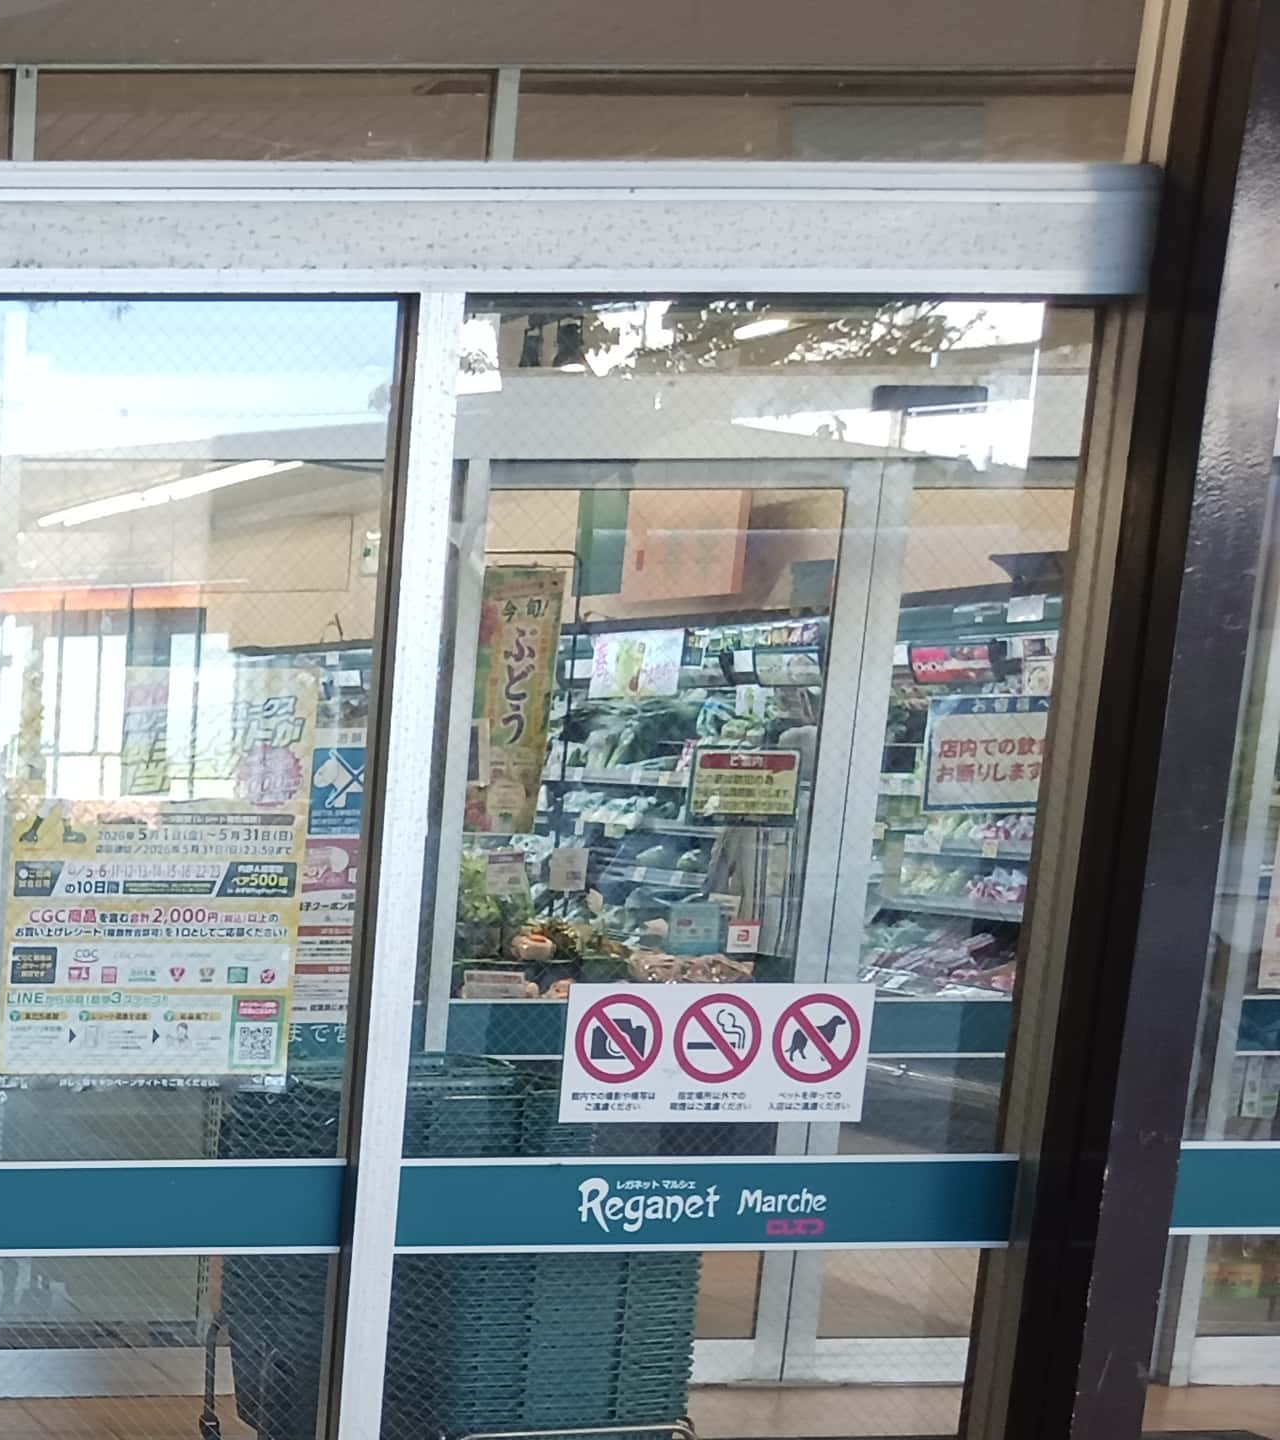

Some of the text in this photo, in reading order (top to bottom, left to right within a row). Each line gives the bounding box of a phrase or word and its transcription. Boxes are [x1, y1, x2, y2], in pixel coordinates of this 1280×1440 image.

[501, 626, 537, 745] ぶどう
[578, 1177, 721, 1233] Reganet
[737, 1187, 828, 1216] Marche
[616, 1179, 697, 1190] レガネット マルシェ
